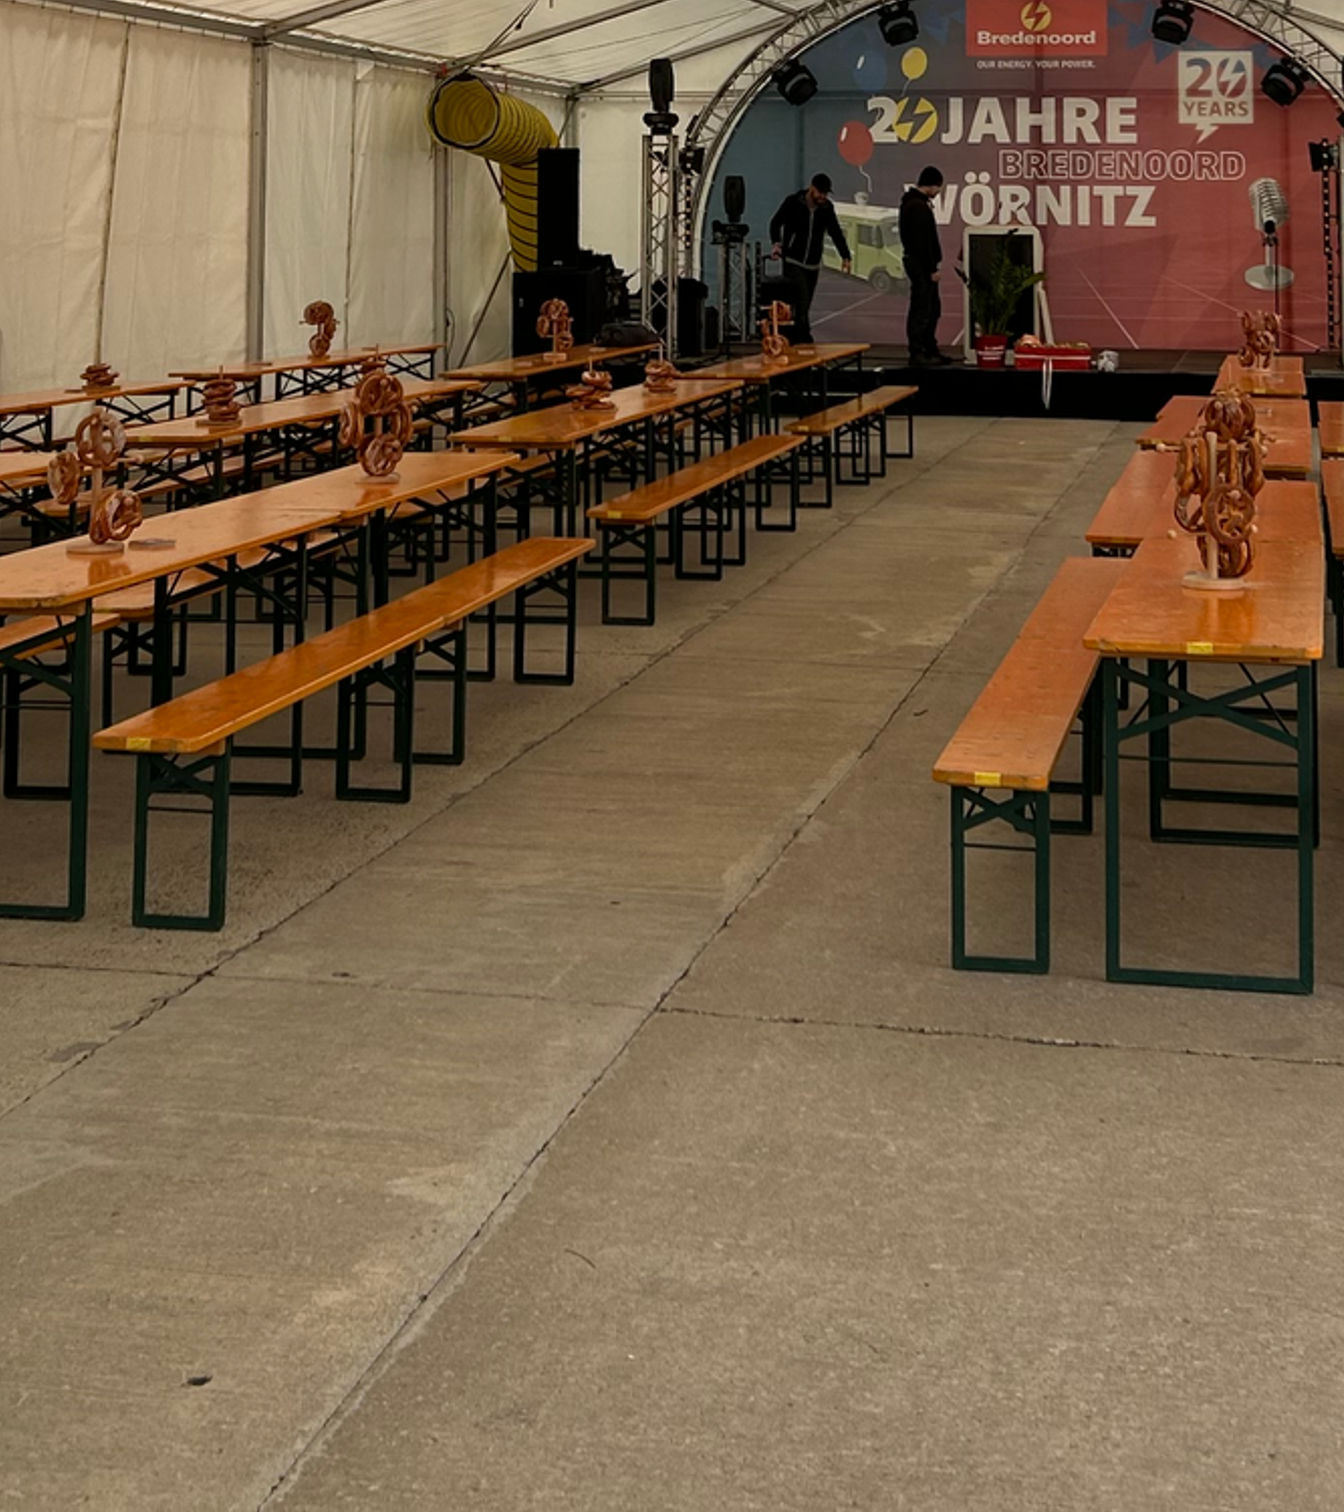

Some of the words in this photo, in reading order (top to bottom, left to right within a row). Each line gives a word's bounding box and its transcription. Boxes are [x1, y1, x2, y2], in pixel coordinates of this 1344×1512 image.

[977, 31, 1096, 44] Bredenoord
[976, 60, 996, 68] OUR
[1035, 60, 1060, 68] YOUR
[1186, 57, 1247, 98] 20
[941, 96, 1138, 144] JAHRE
[1183, 101, 1249, 117] YEARS
[999, 149, 1246, 180] BREDENOORD
